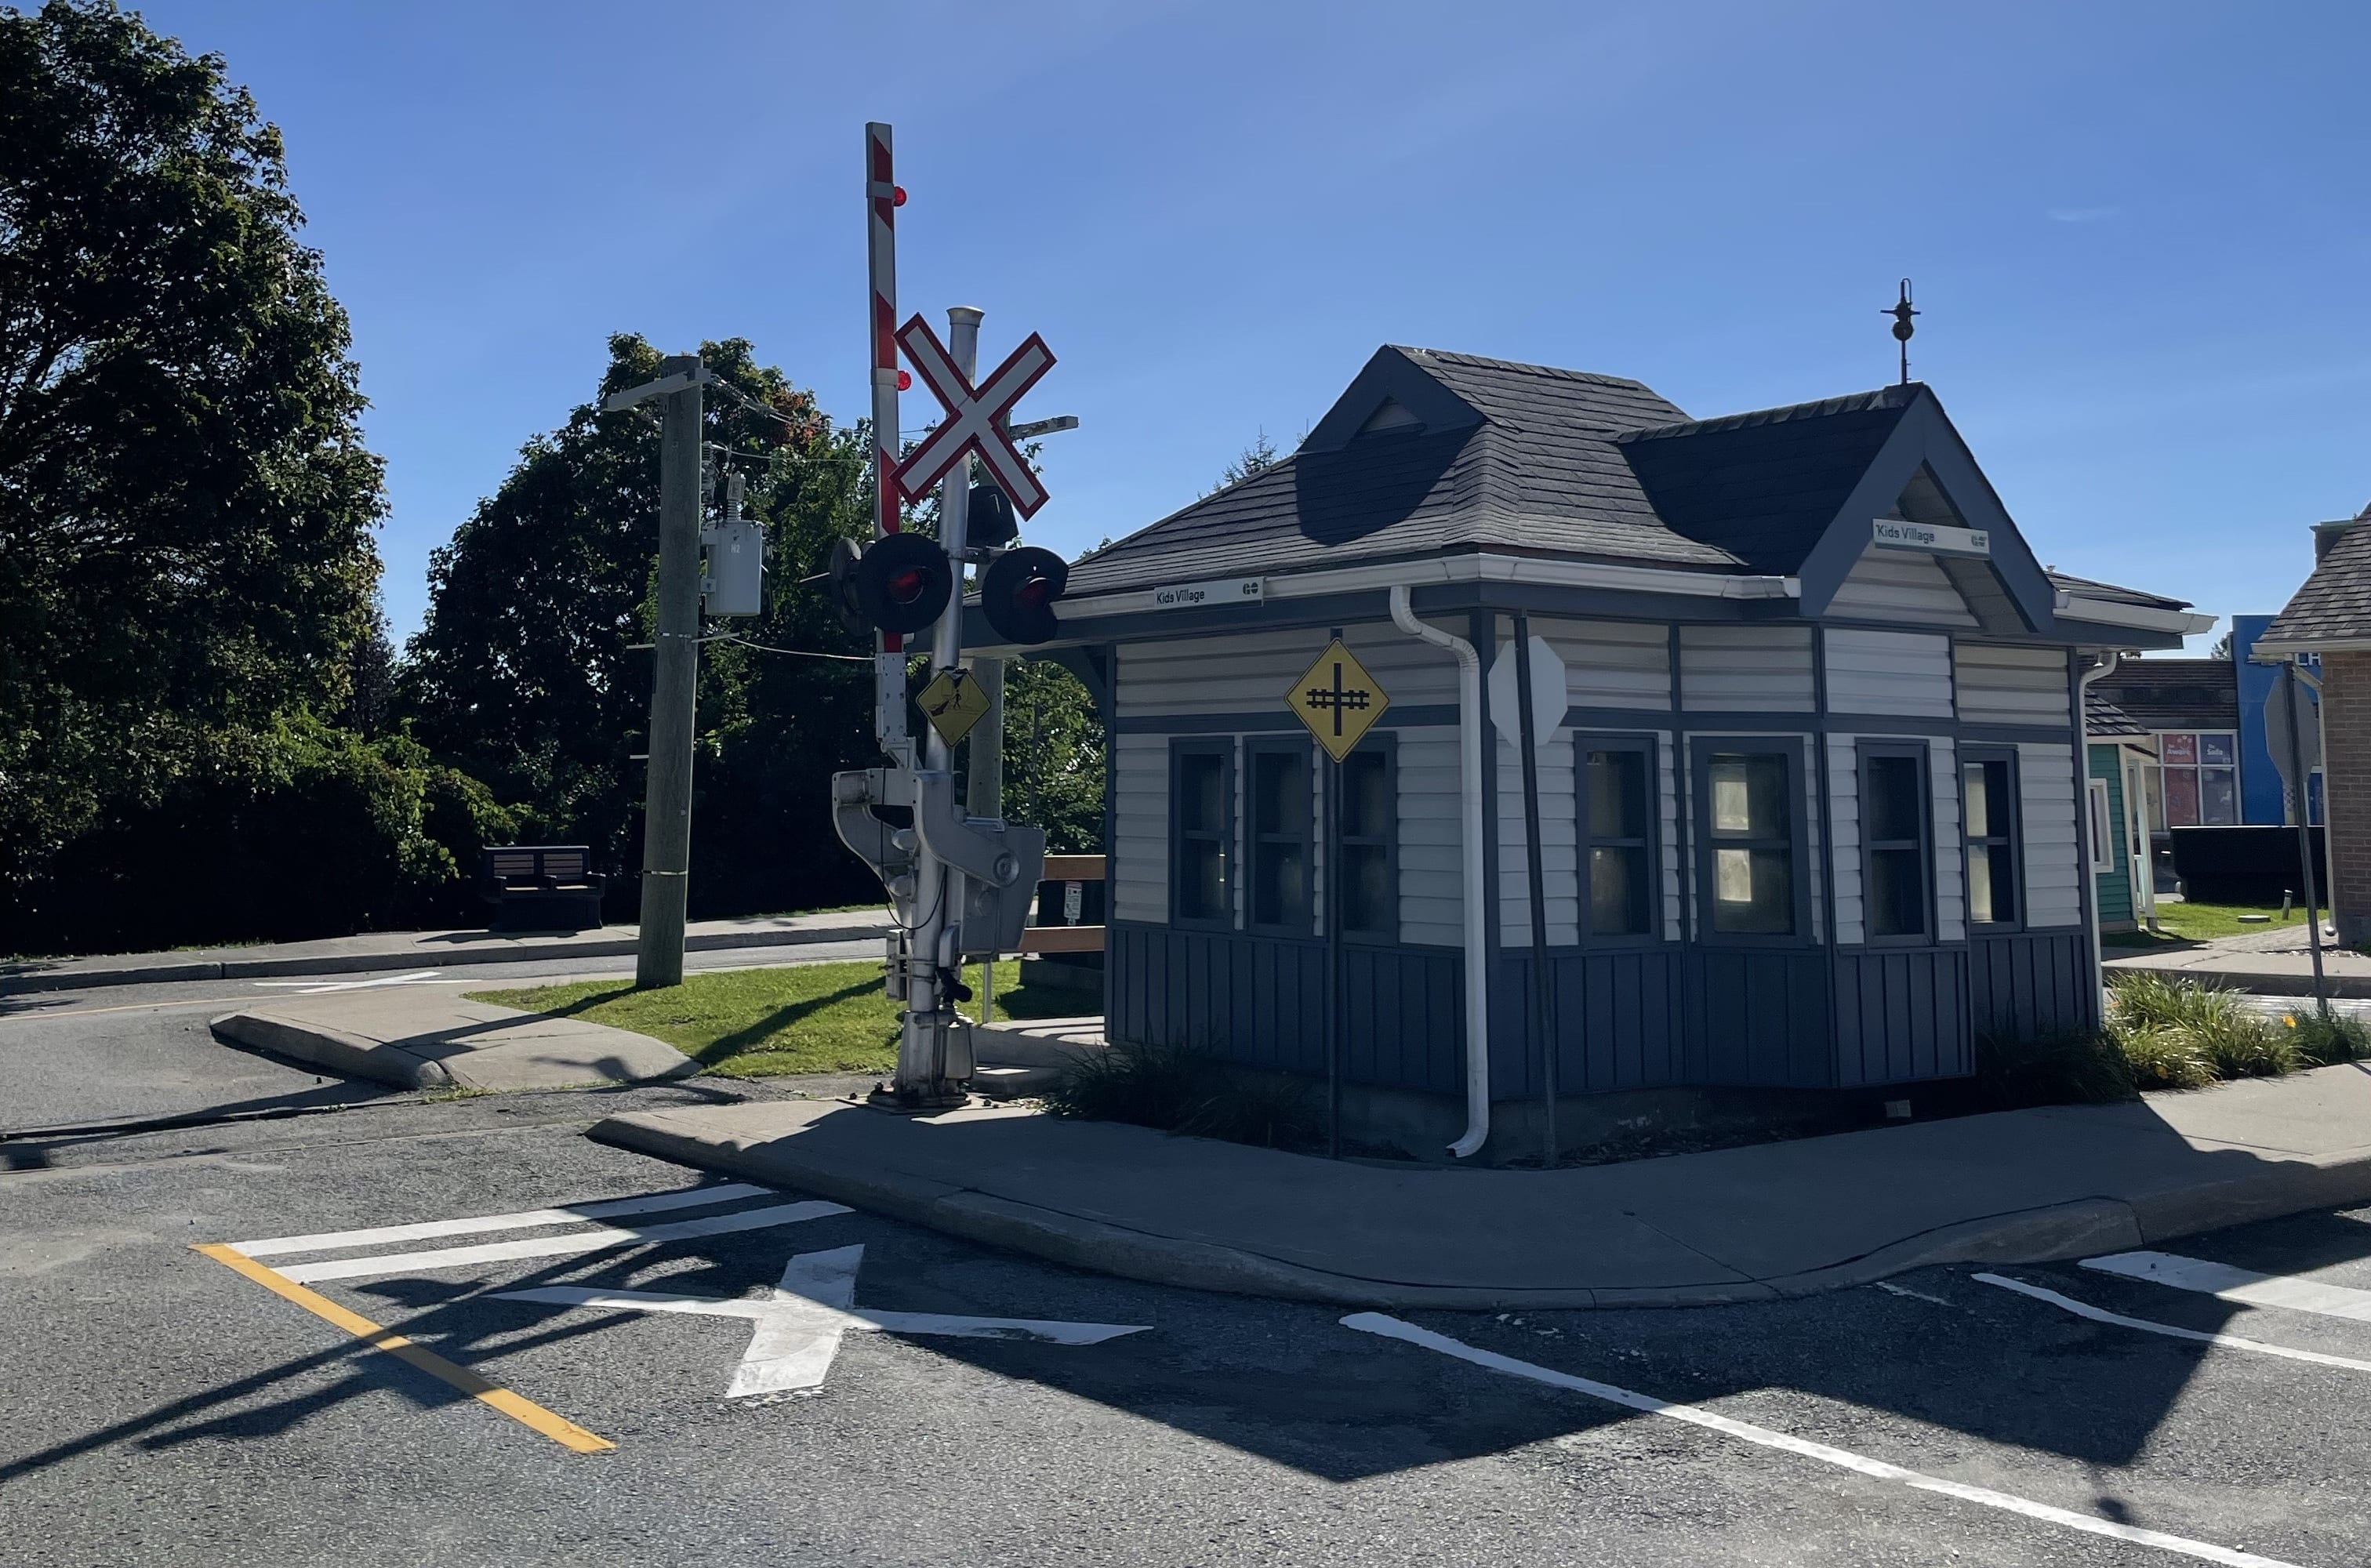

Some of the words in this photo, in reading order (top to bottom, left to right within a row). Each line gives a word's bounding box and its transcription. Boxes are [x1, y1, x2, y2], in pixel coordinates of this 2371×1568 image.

[1875, 524, 1900, 539] Kids
[1901, 527, 1935, 544] Village
[1156, 592, 1174, 604] Kids
[1175, 589, 1205, 603] Village
